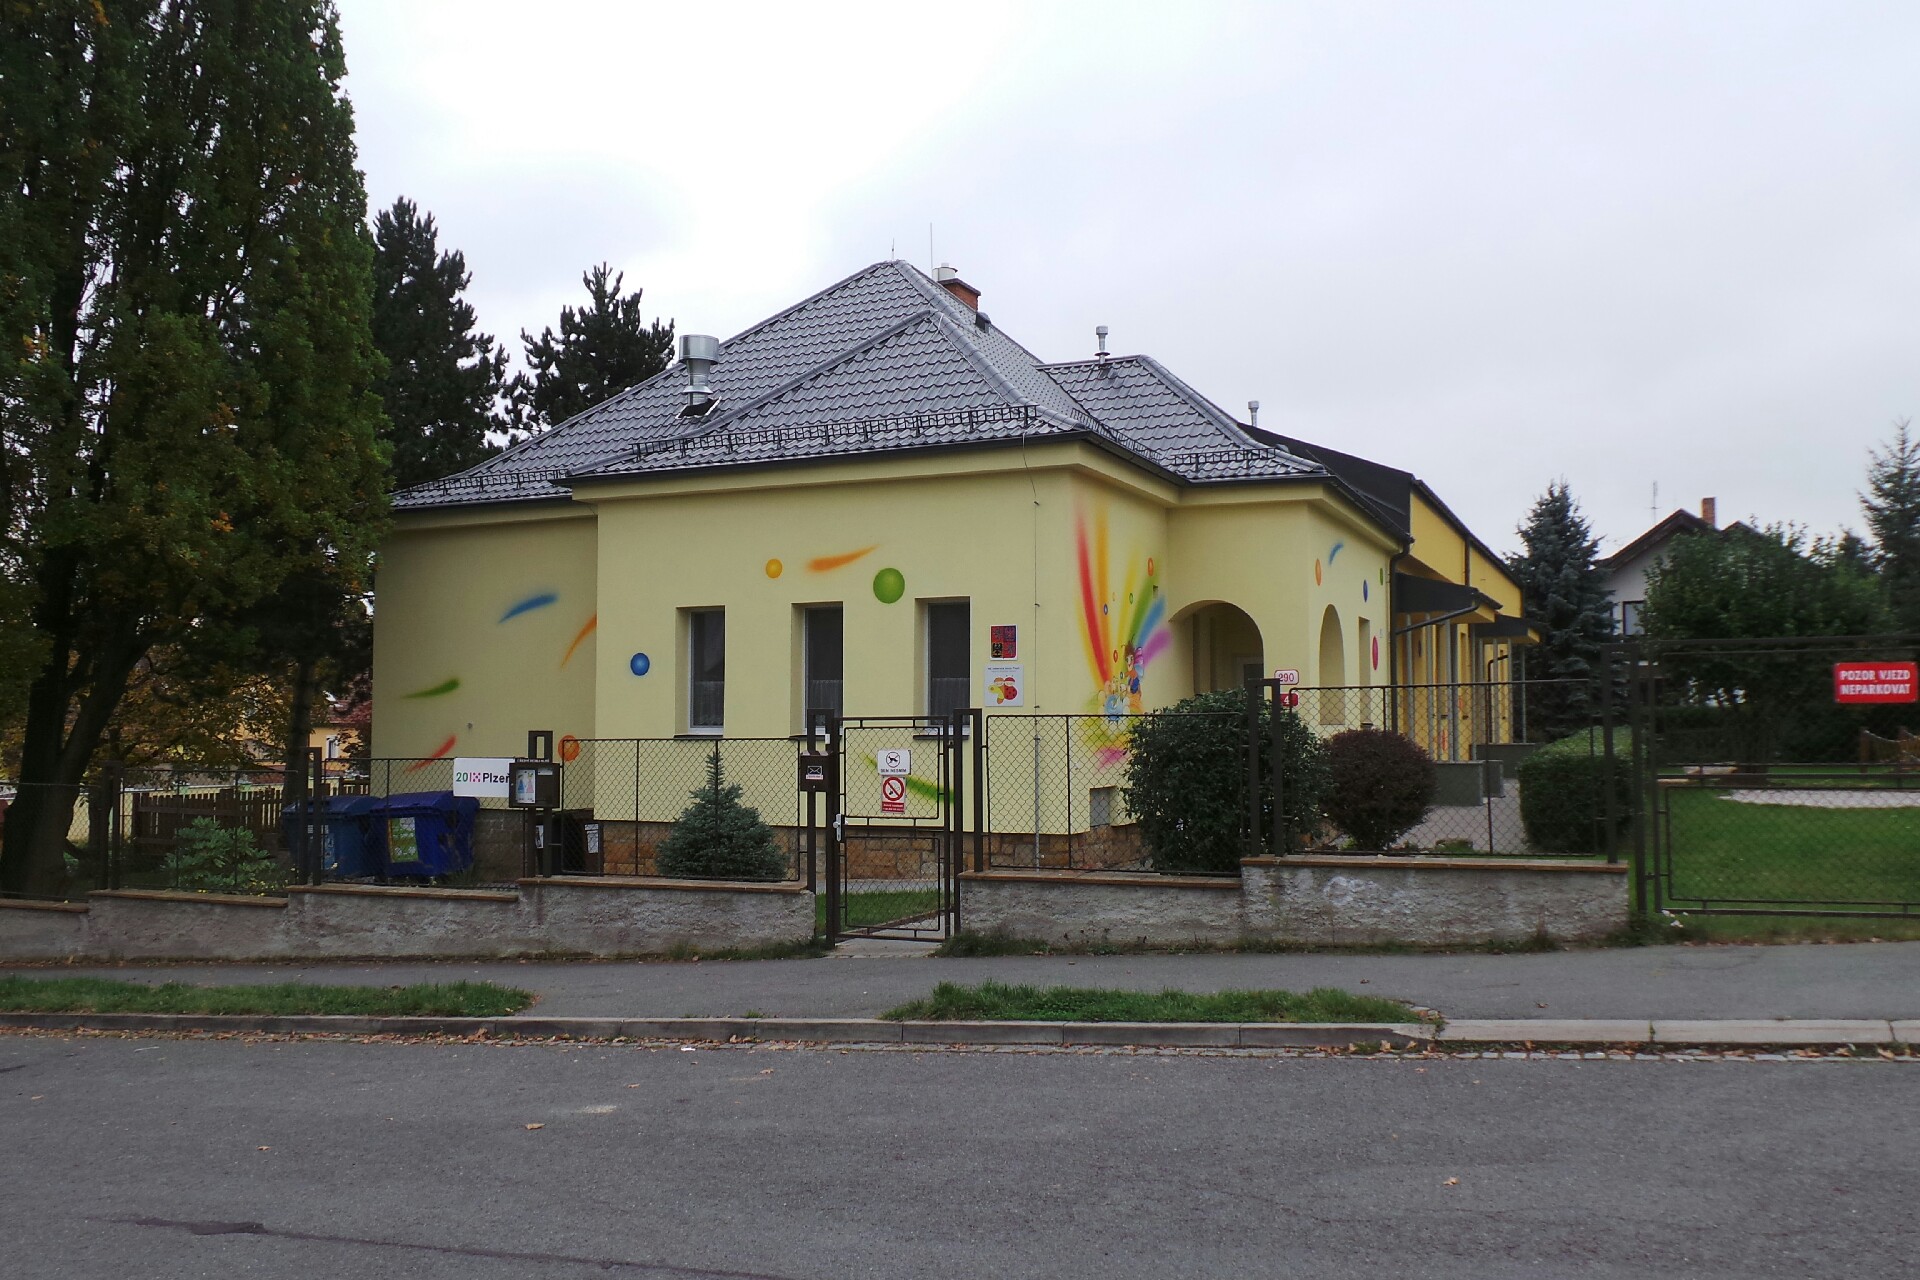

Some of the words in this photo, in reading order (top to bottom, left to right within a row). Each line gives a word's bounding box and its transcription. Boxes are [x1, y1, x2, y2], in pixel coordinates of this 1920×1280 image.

[1279, 672, 1295, 682] 290
[1840, 670, 1875, 680] POZOR
[1879, 669, 1911, 680] VJEZD
[1840, 683, 1911, 695] NEPARKOVAT
